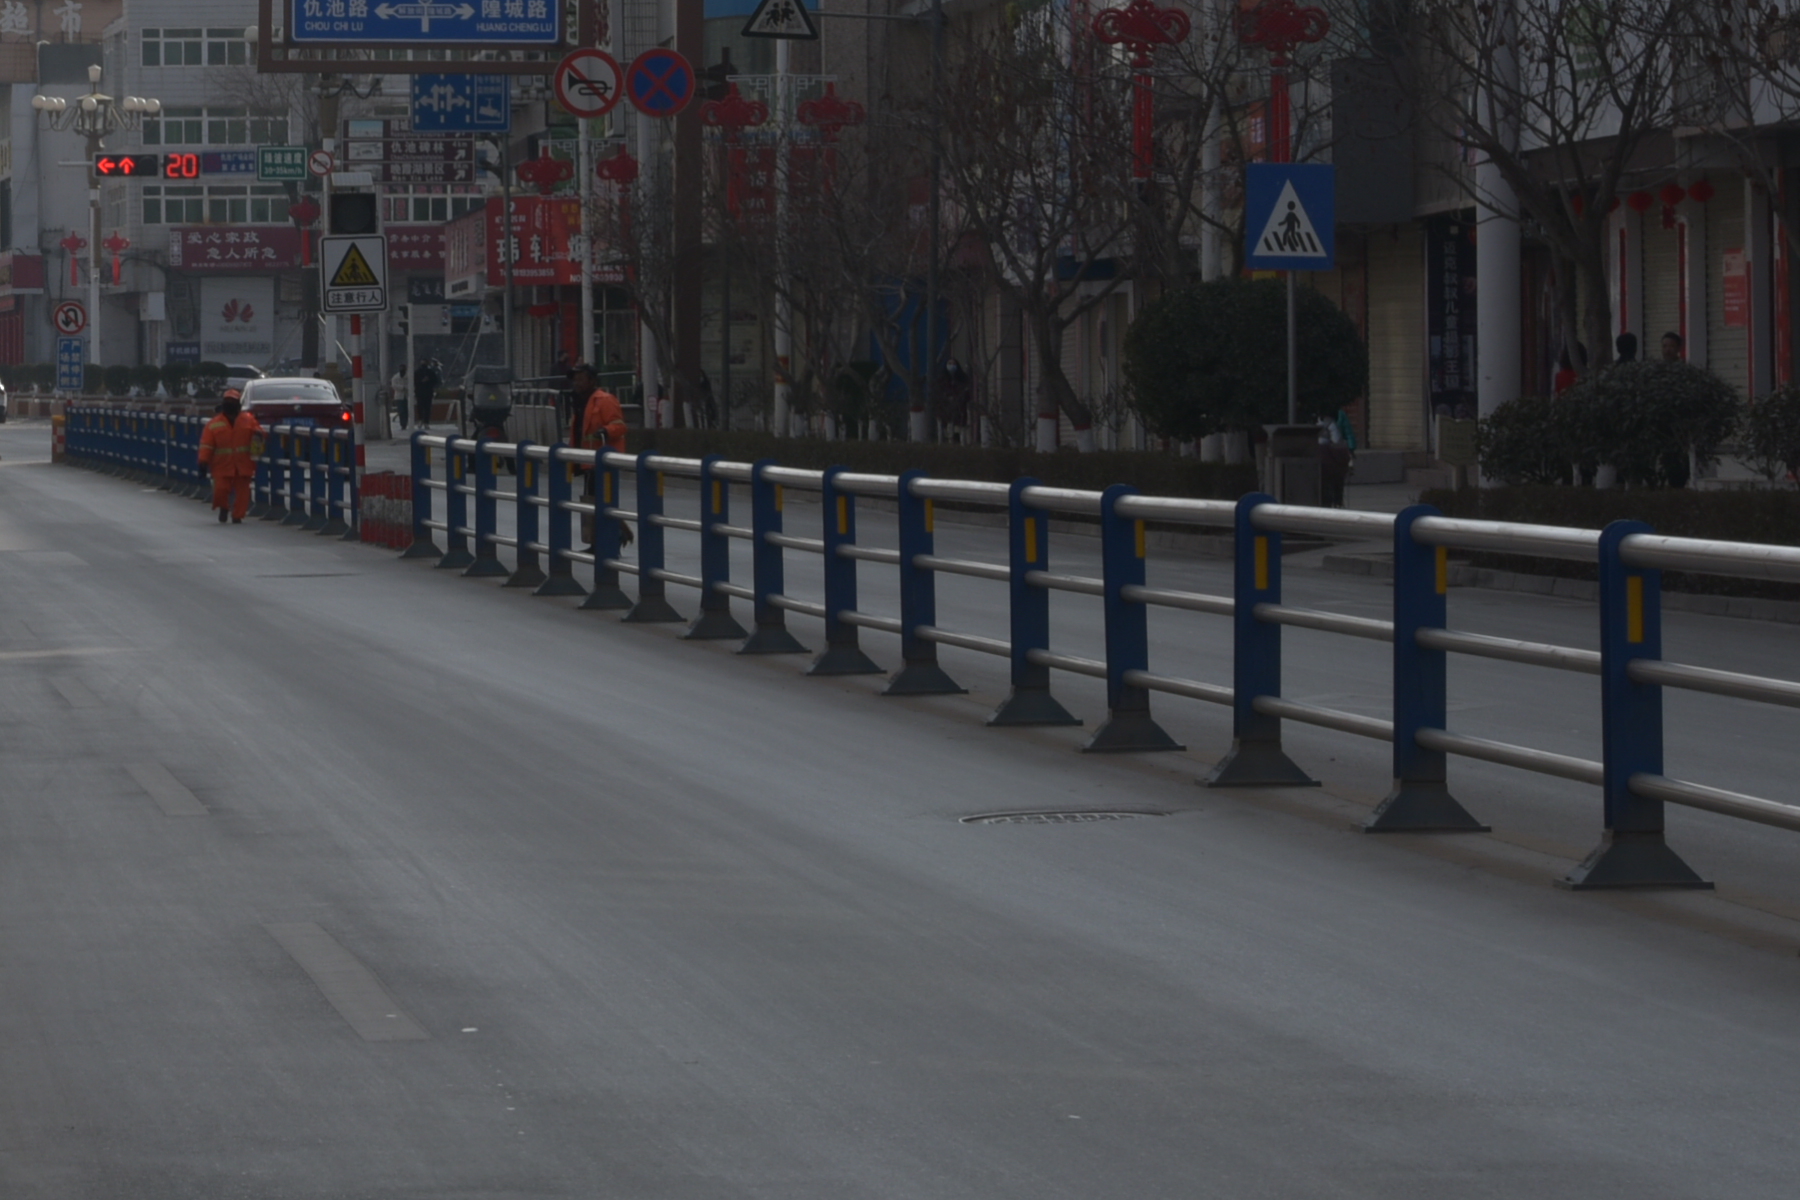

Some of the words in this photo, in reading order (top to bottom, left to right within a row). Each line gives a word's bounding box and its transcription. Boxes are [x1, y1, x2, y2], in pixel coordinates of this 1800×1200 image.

[481, 0, 548, 19] 隍城路
[304, 21, 330, 31] CHOU
[334, 21, 349, 31] CHI
[352, 21, 364, 31] LU
[476, 23, 507, 33] HUANG
[508, 23, 539, 33] CHENG
[541, 23, 553, 33] LU
[166, 153, 198, 179] 20
[186, 230, 261, 245] 爱心家政
[206, 246, 278, 260] 急人所急
[329, 289, 381, 305] 注意行人
